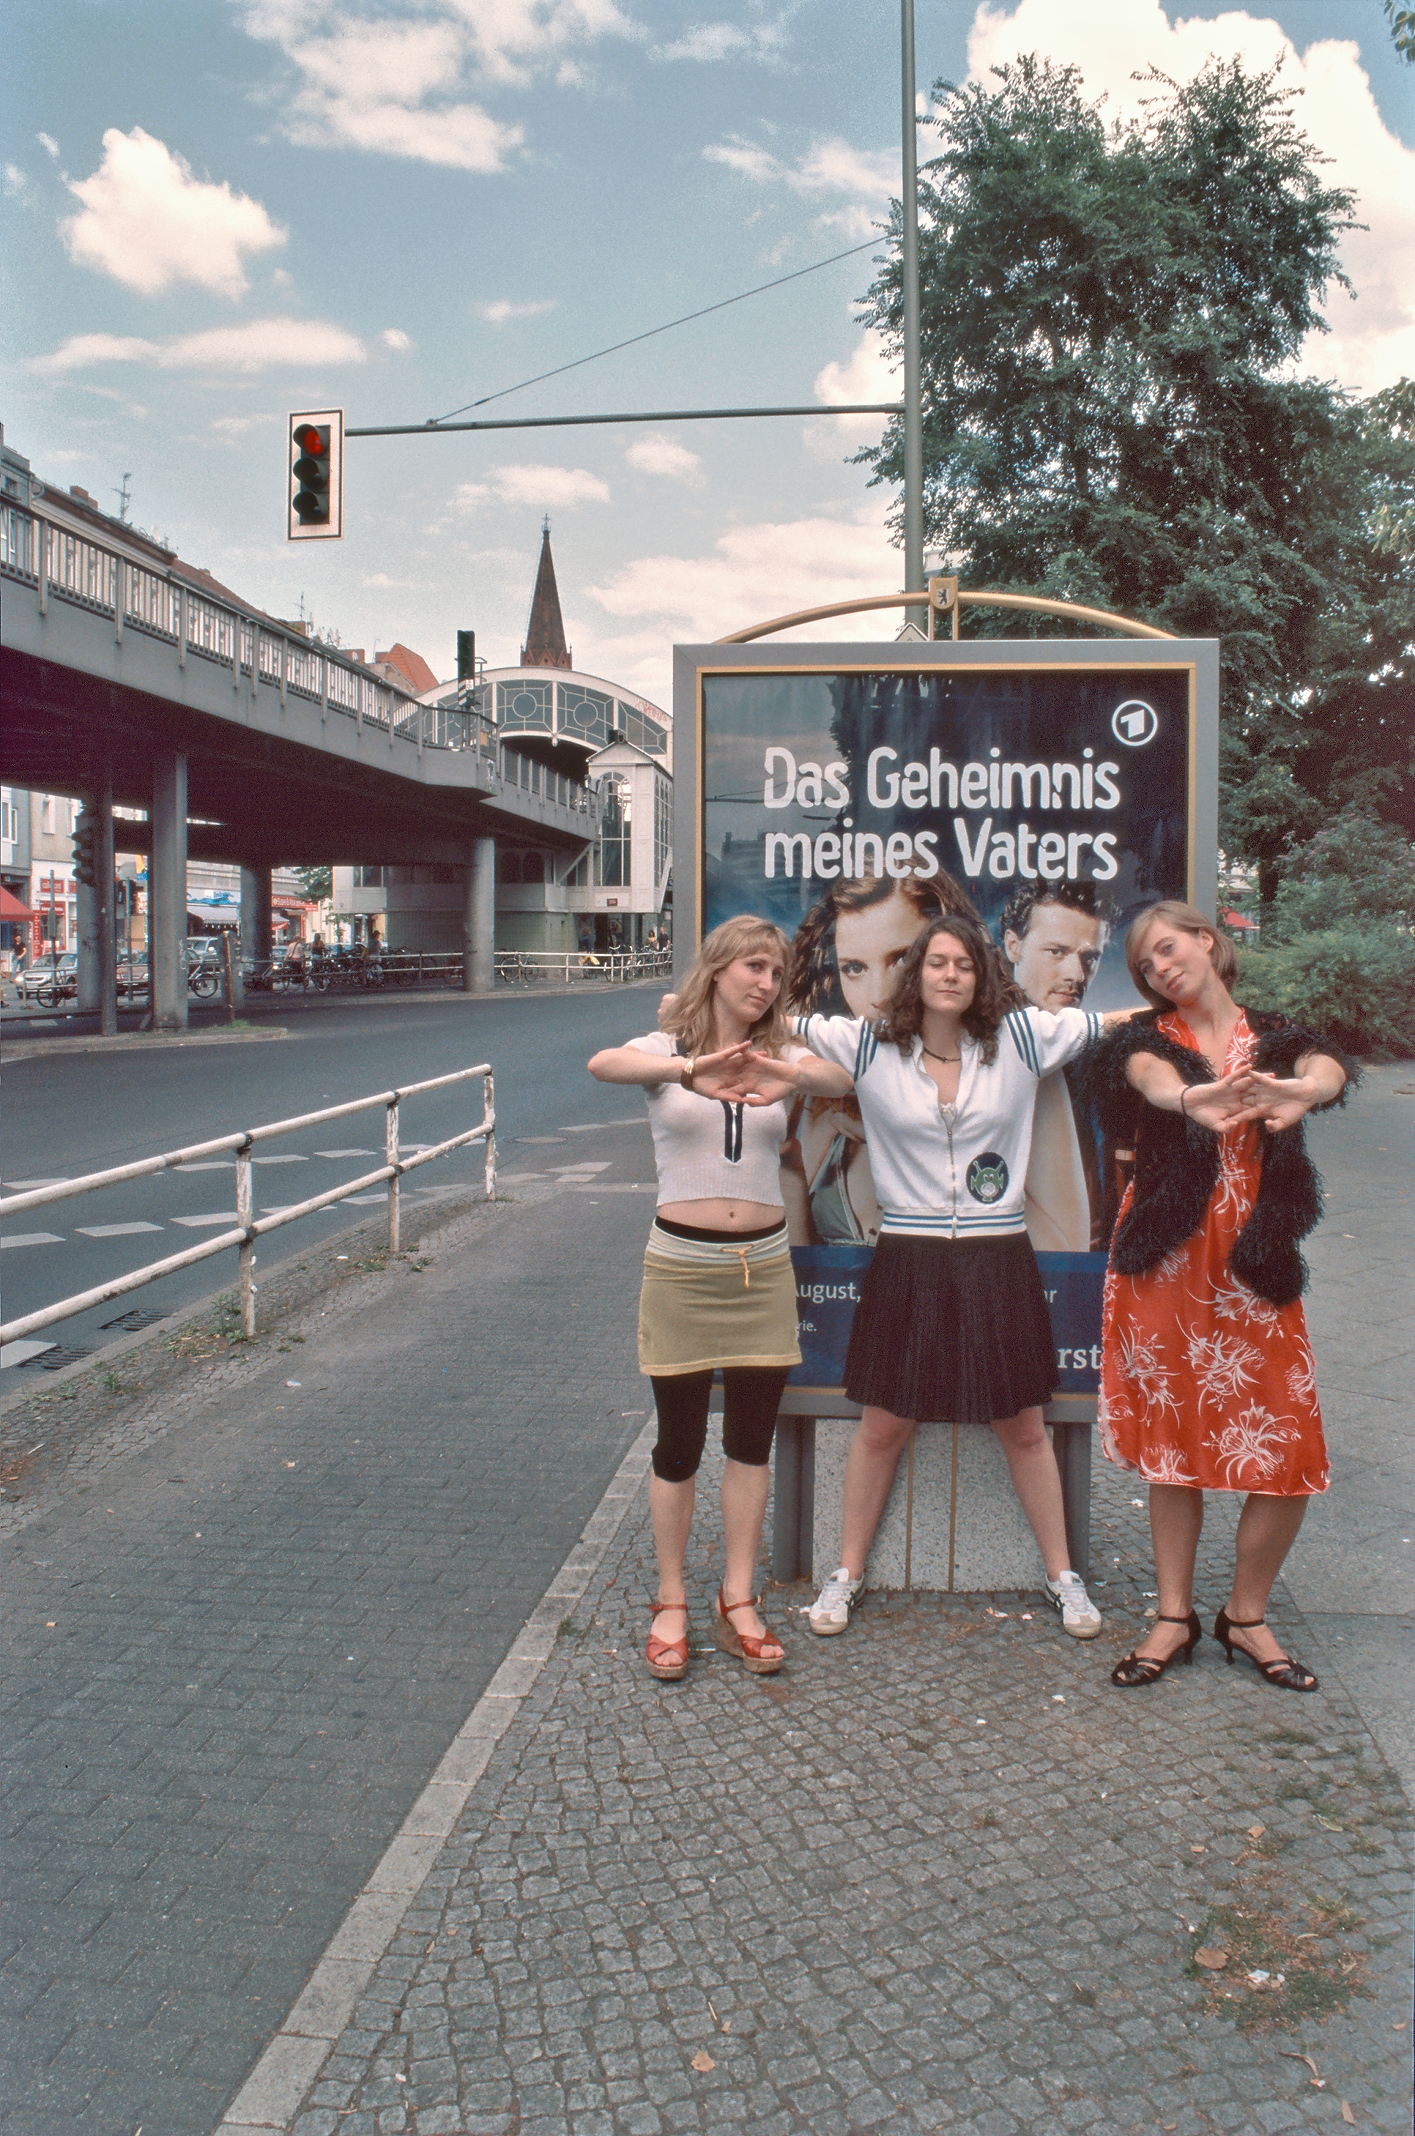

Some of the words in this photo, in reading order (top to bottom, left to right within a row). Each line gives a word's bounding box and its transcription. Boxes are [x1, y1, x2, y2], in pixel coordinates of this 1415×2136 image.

[764, 746, 850, 809] Das
[867, 746, 1121, 810] Geheimnis
[764, 817, 939, 879] meines
[953, 817, 1119, 880] Vaters
[796, 1282, 861, 1304] ugust,
[1057, 1344, 1102, 1370] rst
